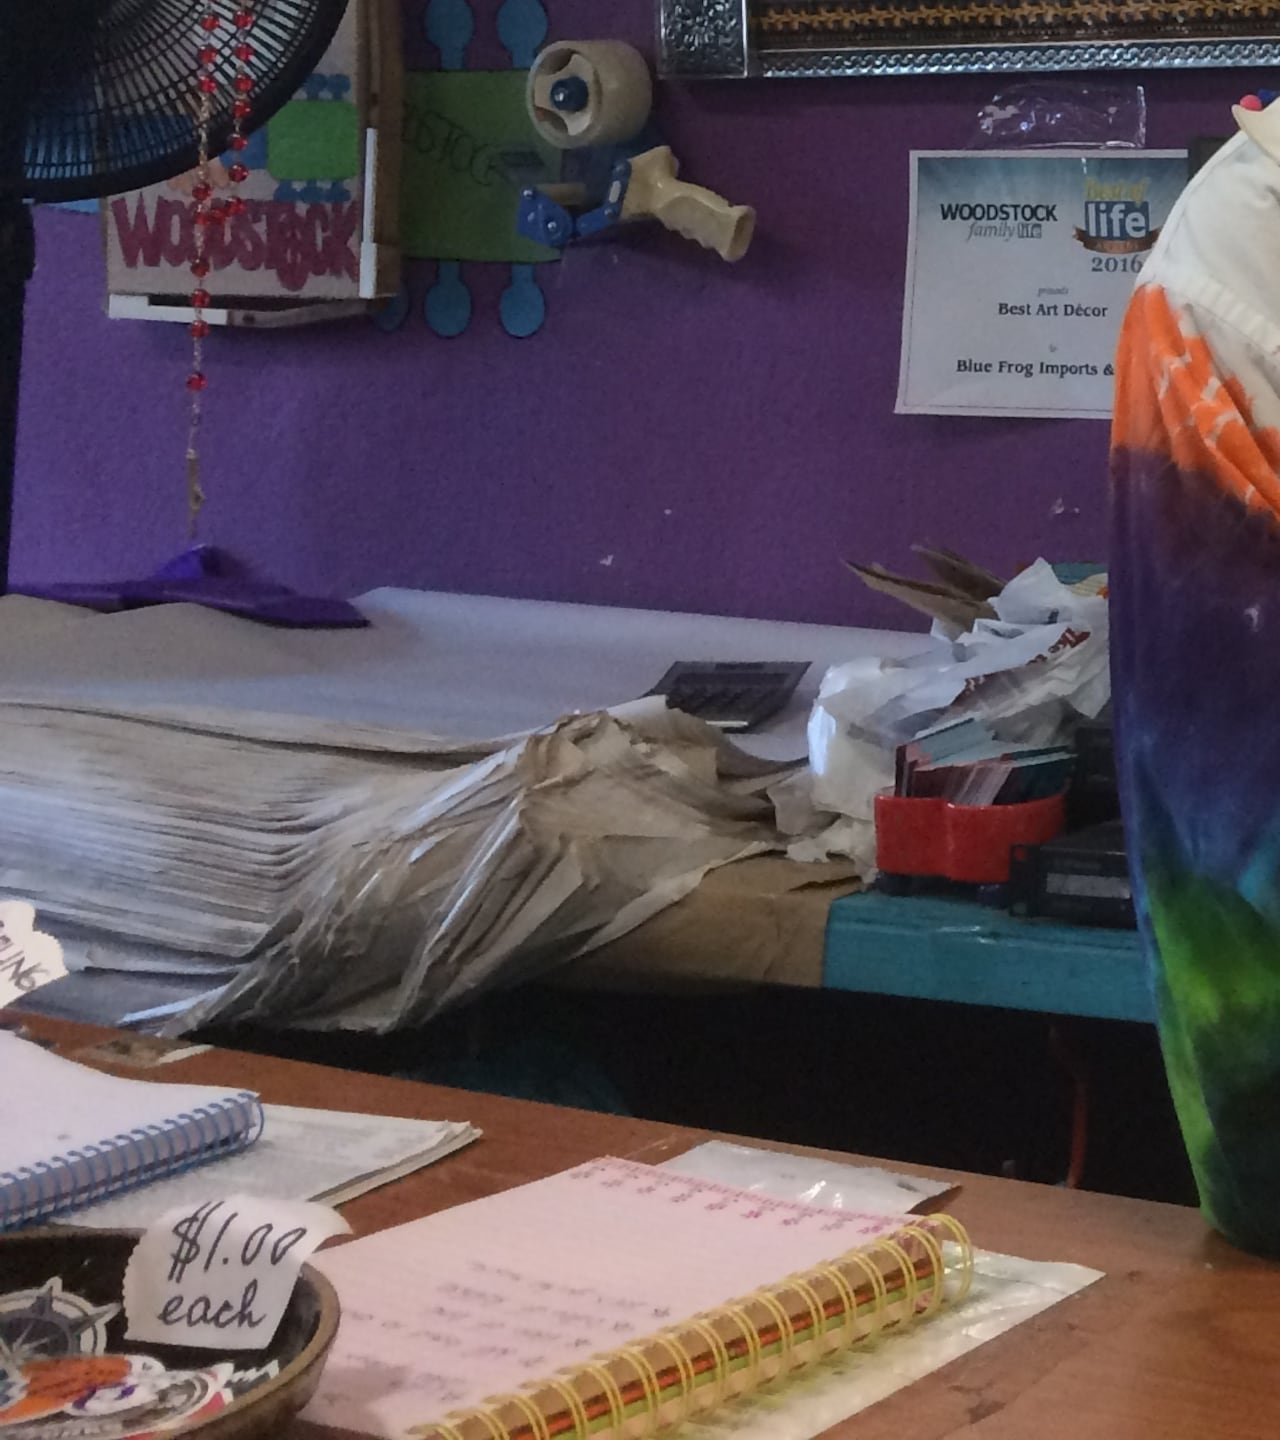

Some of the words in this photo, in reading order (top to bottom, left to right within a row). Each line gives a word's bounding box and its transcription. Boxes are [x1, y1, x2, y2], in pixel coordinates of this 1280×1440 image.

[940, 203, 1058, 222] WOODSTOCK
[1087, 203, 1147, 239] life
[967, 222, 1016, 242] family
[1091, 256, 1143, 273] 2016
[998, 302, 1032, 317] Best
[1036, 303, 1060, 317] Art
[1063, 302, 1108, 318] Décor
[956, 359, 993, 374] Blue
[998, 360, 1034, 379] Frog
[1039, 361, 1098, 380] Imports
[1102, 362, 1115, 376] &
[168, 1201, 307, 1283] $1.00
[157, 1279, 267, 1328] each
